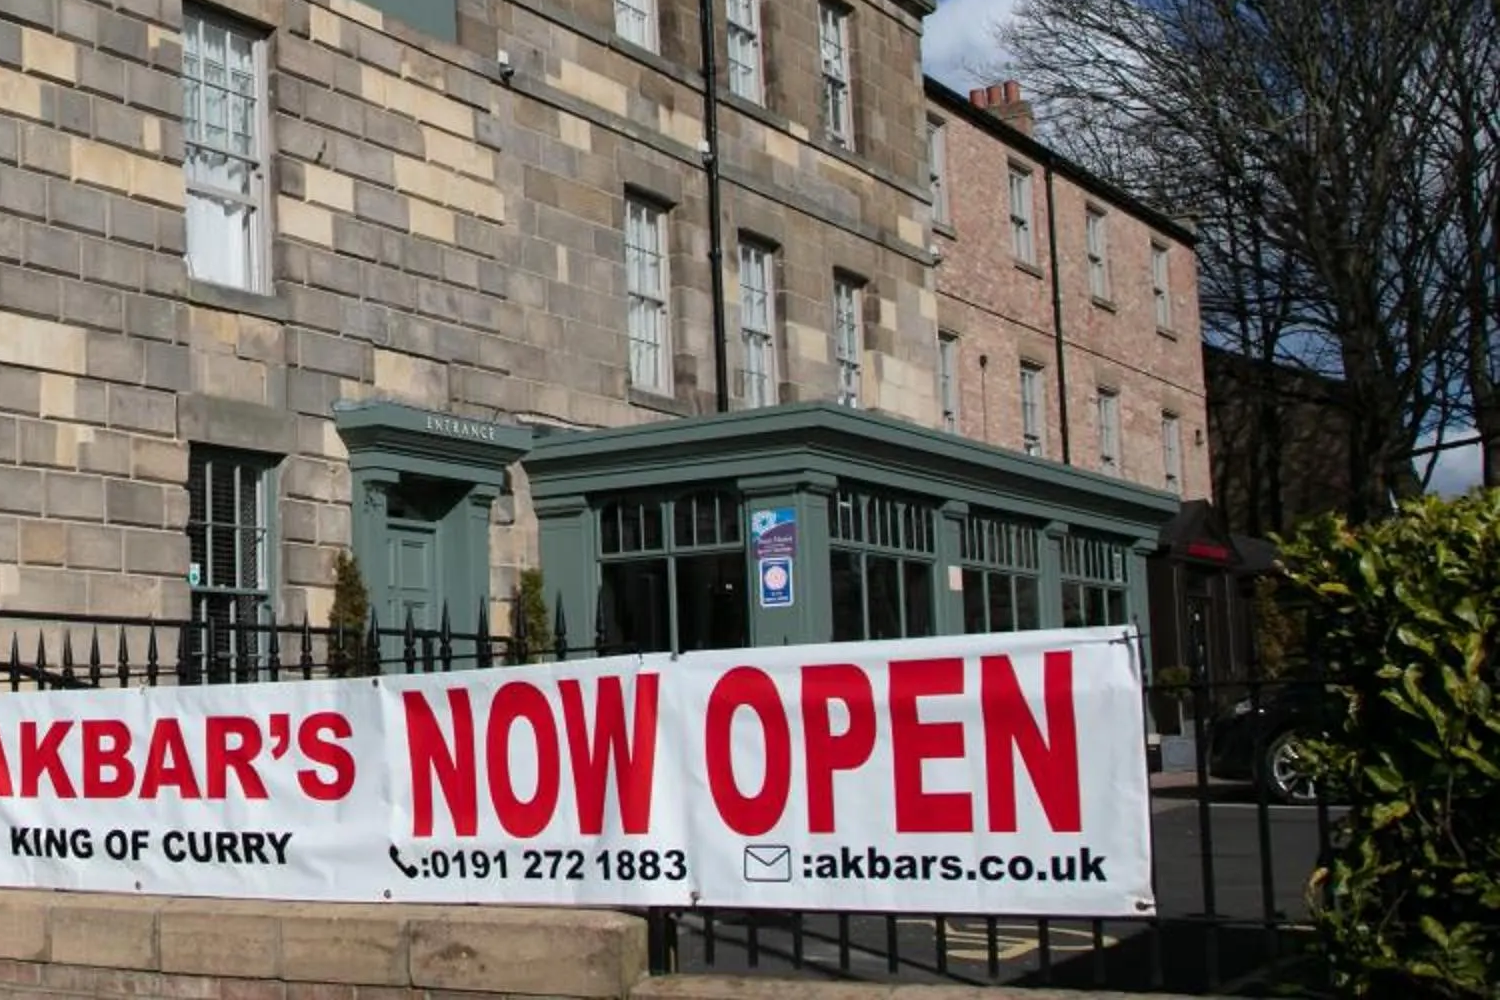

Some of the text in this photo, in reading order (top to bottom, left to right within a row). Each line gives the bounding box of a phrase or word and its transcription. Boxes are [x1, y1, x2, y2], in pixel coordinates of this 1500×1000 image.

[425, 415, 496, 441] ENTRANCE
[403, 651, 1082, 838] NOW OPEN
[10, 826, 293, 865] KING OF CURRY
[523, 849, 585, 880] 272
[595, 849, 687, 881] 1883
